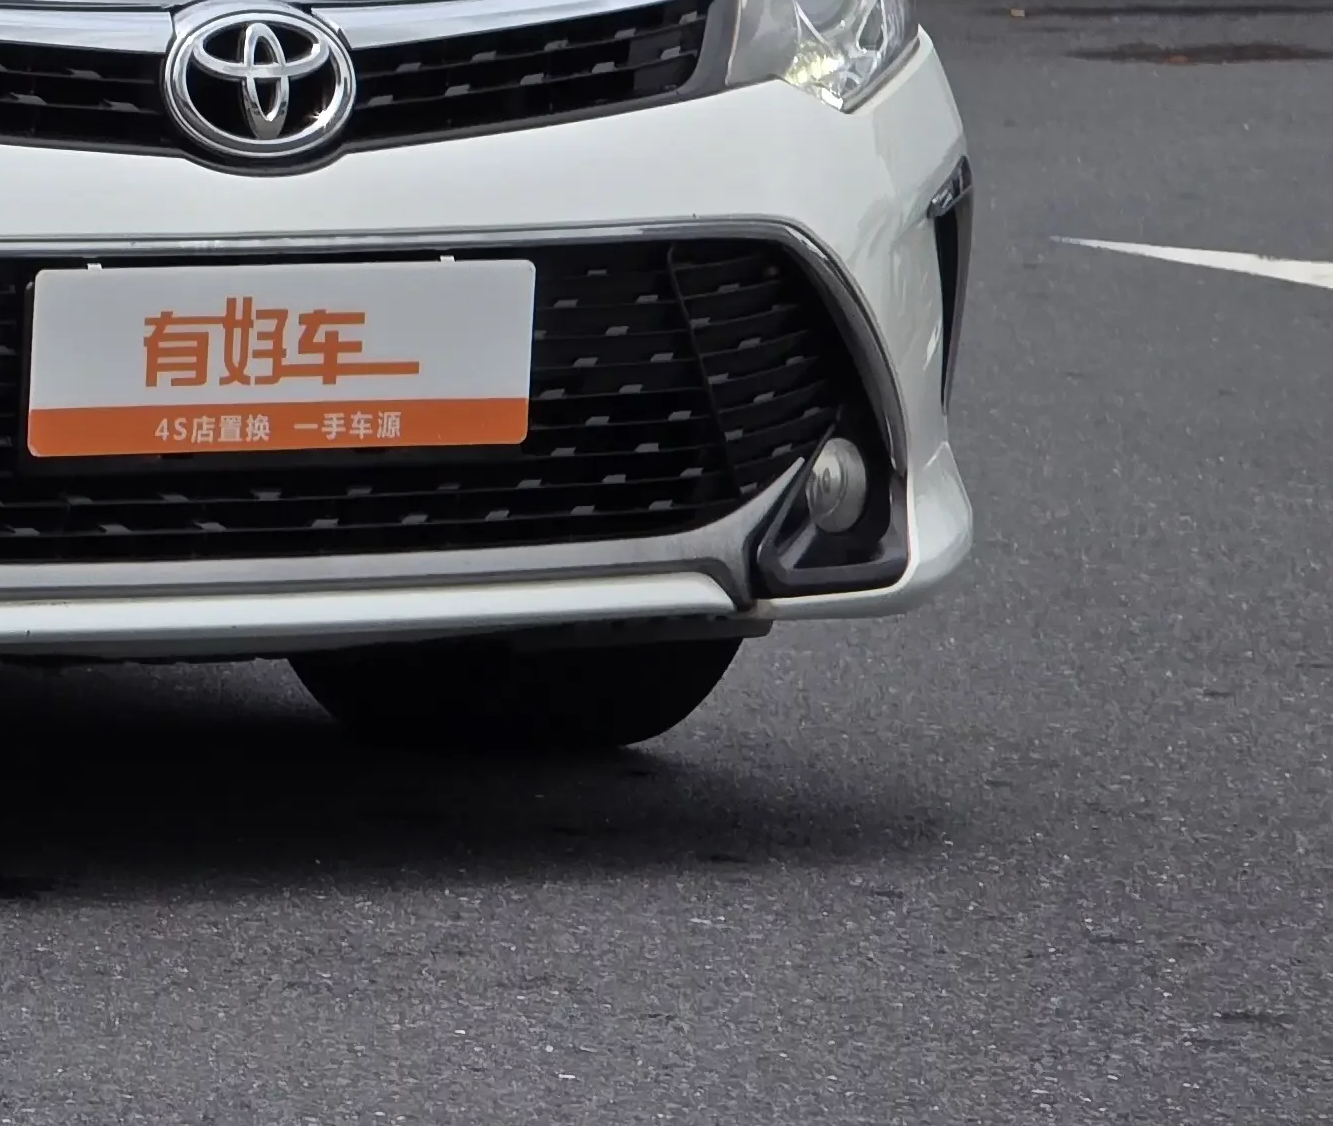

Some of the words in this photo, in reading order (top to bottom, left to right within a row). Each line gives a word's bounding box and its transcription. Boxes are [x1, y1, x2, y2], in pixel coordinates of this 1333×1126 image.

[142, 296, 420, 387] 有好车
[154, 413, 271, 444] 4S店置换
[293, 410, 402, 441] 一手车源
